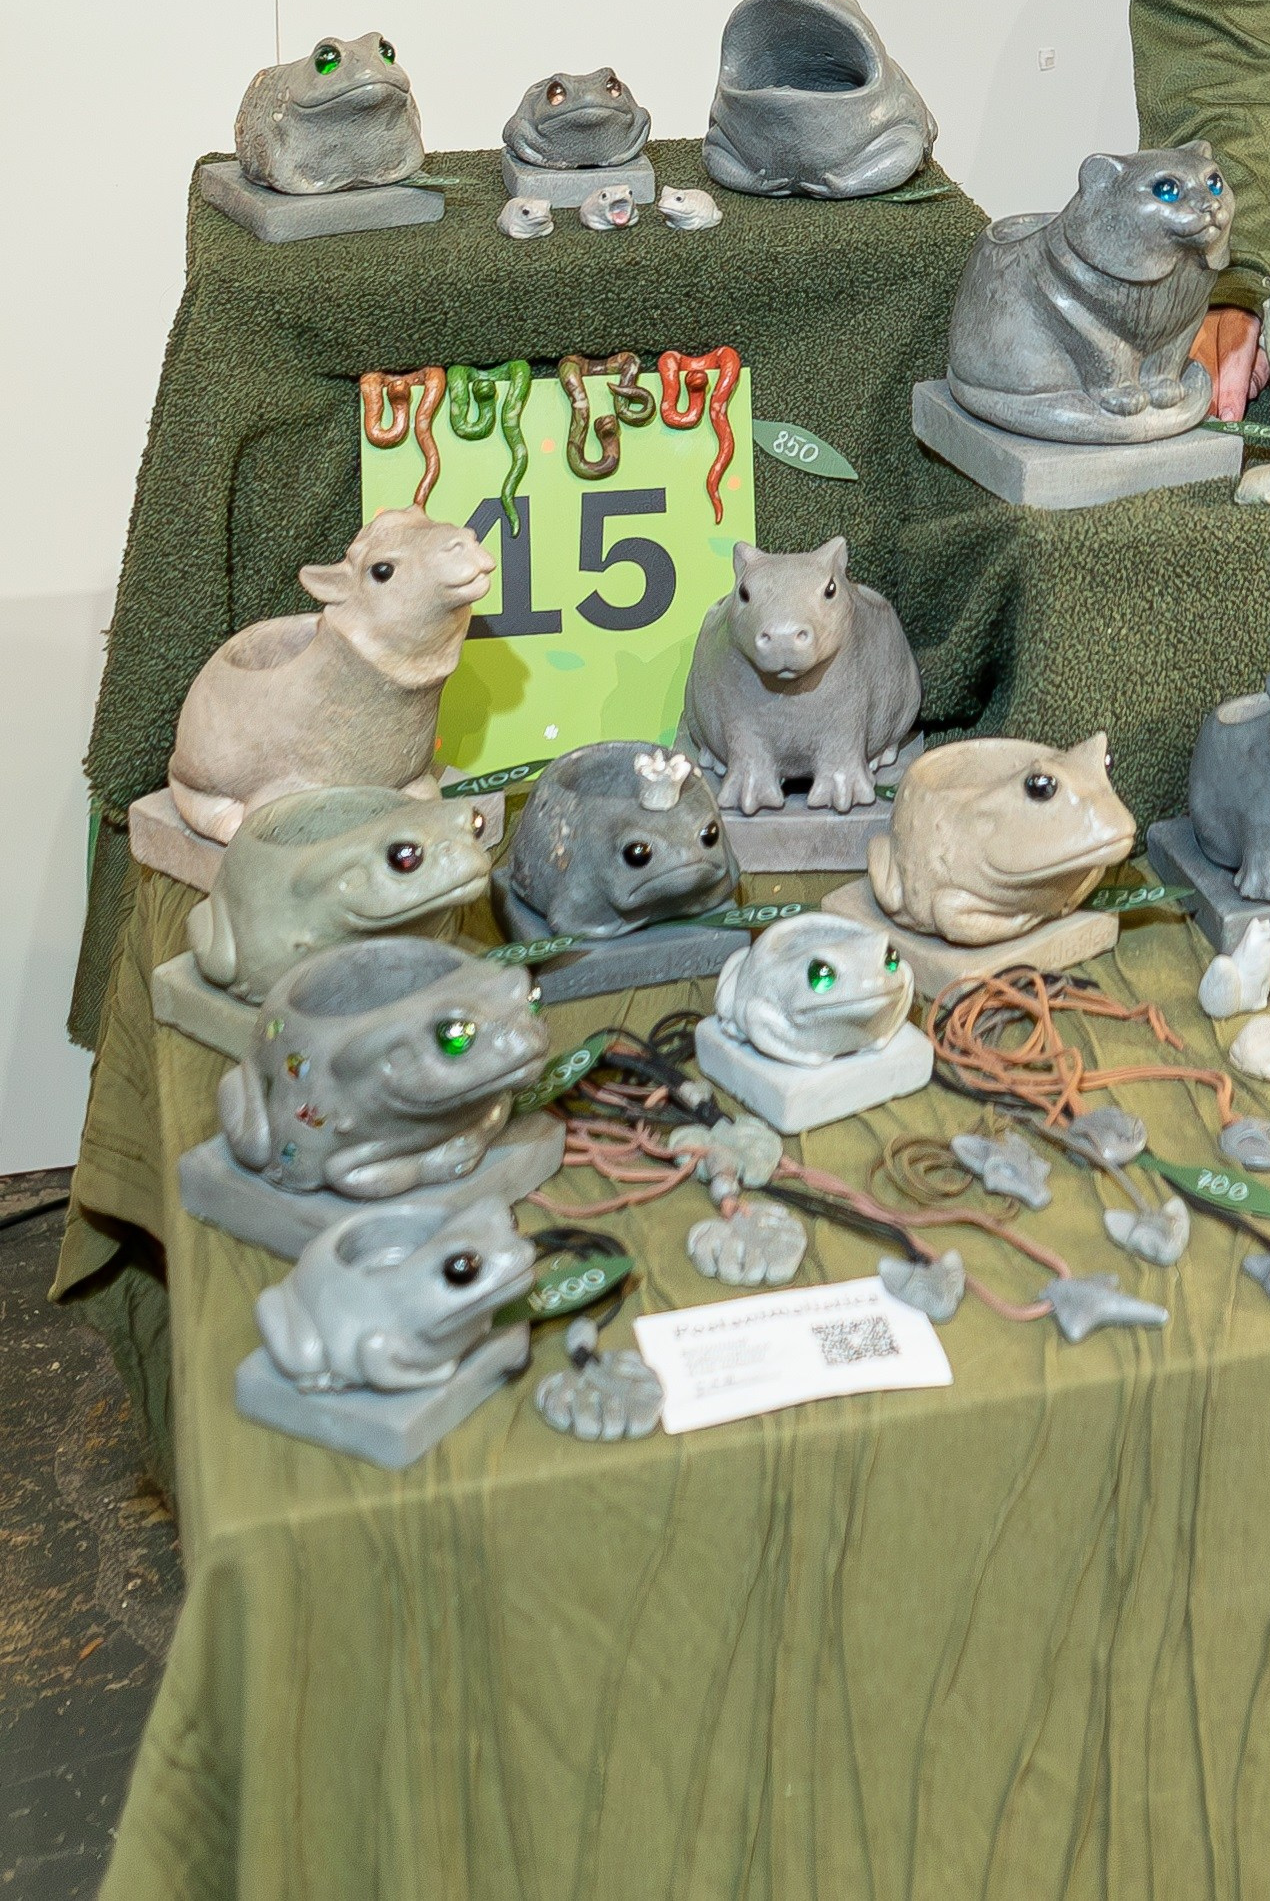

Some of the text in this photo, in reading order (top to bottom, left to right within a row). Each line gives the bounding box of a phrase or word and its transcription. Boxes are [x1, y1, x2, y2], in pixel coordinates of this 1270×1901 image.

[773, 430, 819, 463] 850
[464, 487, 677, 640] 15
[456, 765, 530, 793] 4100
